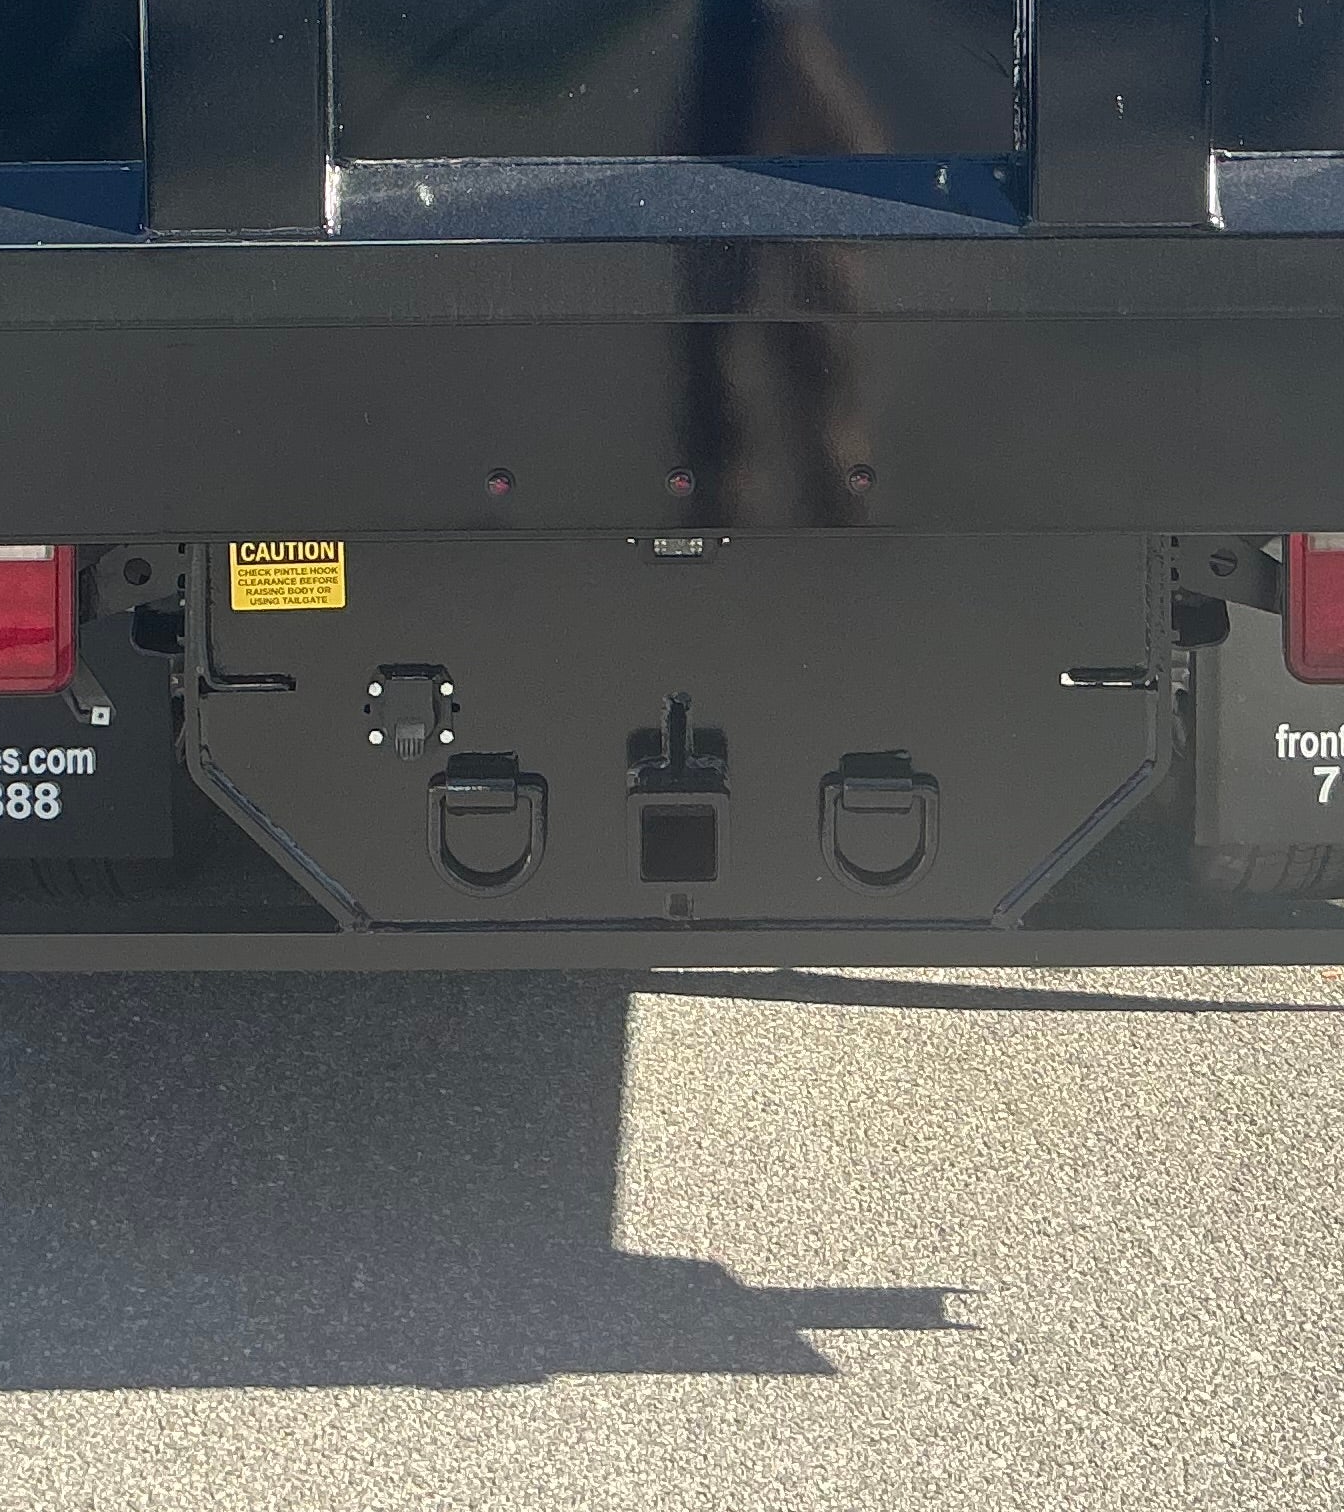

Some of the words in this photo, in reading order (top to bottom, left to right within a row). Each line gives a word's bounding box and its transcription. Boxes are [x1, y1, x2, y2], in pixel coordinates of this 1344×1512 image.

[240, 541, 336, 562] CAUTION
[238, 568, 272, 577] CHECK
[274, 567, 308, 576] PINTLE
[310, 566, 339, 575] HOOK
[238, 577, 297, 587] CLEARANCE
[300, 576, 339, 585] BEFORE
[246, 587, 286, 596] RAISING
[288, 586, 315, 595] BODY
[317, 586, 332, 594] OR
[250, 597, 280, 606] USING
[282, 596, 328, 605] TAILGATE
